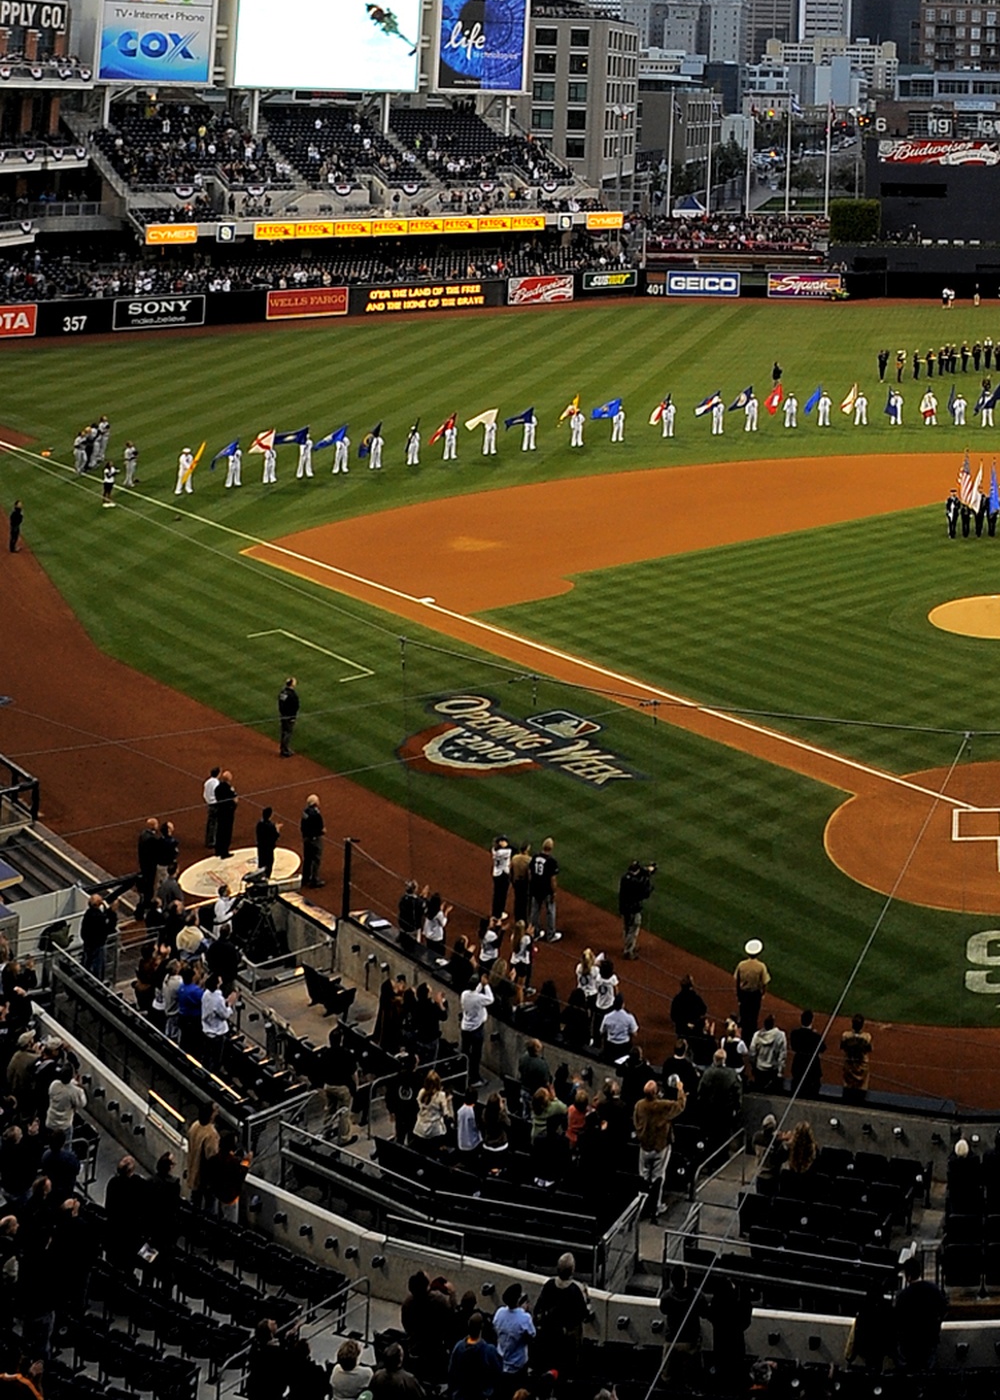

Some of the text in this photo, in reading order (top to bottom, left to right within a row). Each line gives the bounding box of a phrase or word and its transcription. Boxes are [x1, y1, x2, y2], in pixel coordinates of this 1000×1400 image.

[0, 1, 64, 29] PPLY CO.
[115, 9, 205, 22] TV Internet Phone
[117, 30, 200, 64] COX
[444, 20, 486, 60] life
[875, 117, 886, 132] 6
[932, 119, 949, 134] 19
[894, 141, 973, 160] Budweiser
[446, 221, 470, 229] PETCO
[513, 218, 537, 227] PETCO
[588, 217, 622, 226] CYMER
[148, 229, 196, 240] CYMER
[258, 226, 285, 234] PETCO
[590, 274, 630, 286] SUBWAY
[670, 276, 737, 290] GEICO
[776, 276, 836, 295] Sycuan
[370, 285, 480, 299] O'ER THE LAND OF THE FREE
[514, 278, 572, 300] Budweiser
[647, 284, 663, 295] 401
[128, 300, 191, 315] SONY
[270, 295, 345, 307] WELLS FARGO
[366, 296, 484, 312] AND THE HOME OF THE BRAVE
[63, 316, 88, 331] 357
[131, 316, 186, 325] make.believe
[434, 695, 633, 785] OPENING WEEK
[455, 735, 516, 760] 2010
